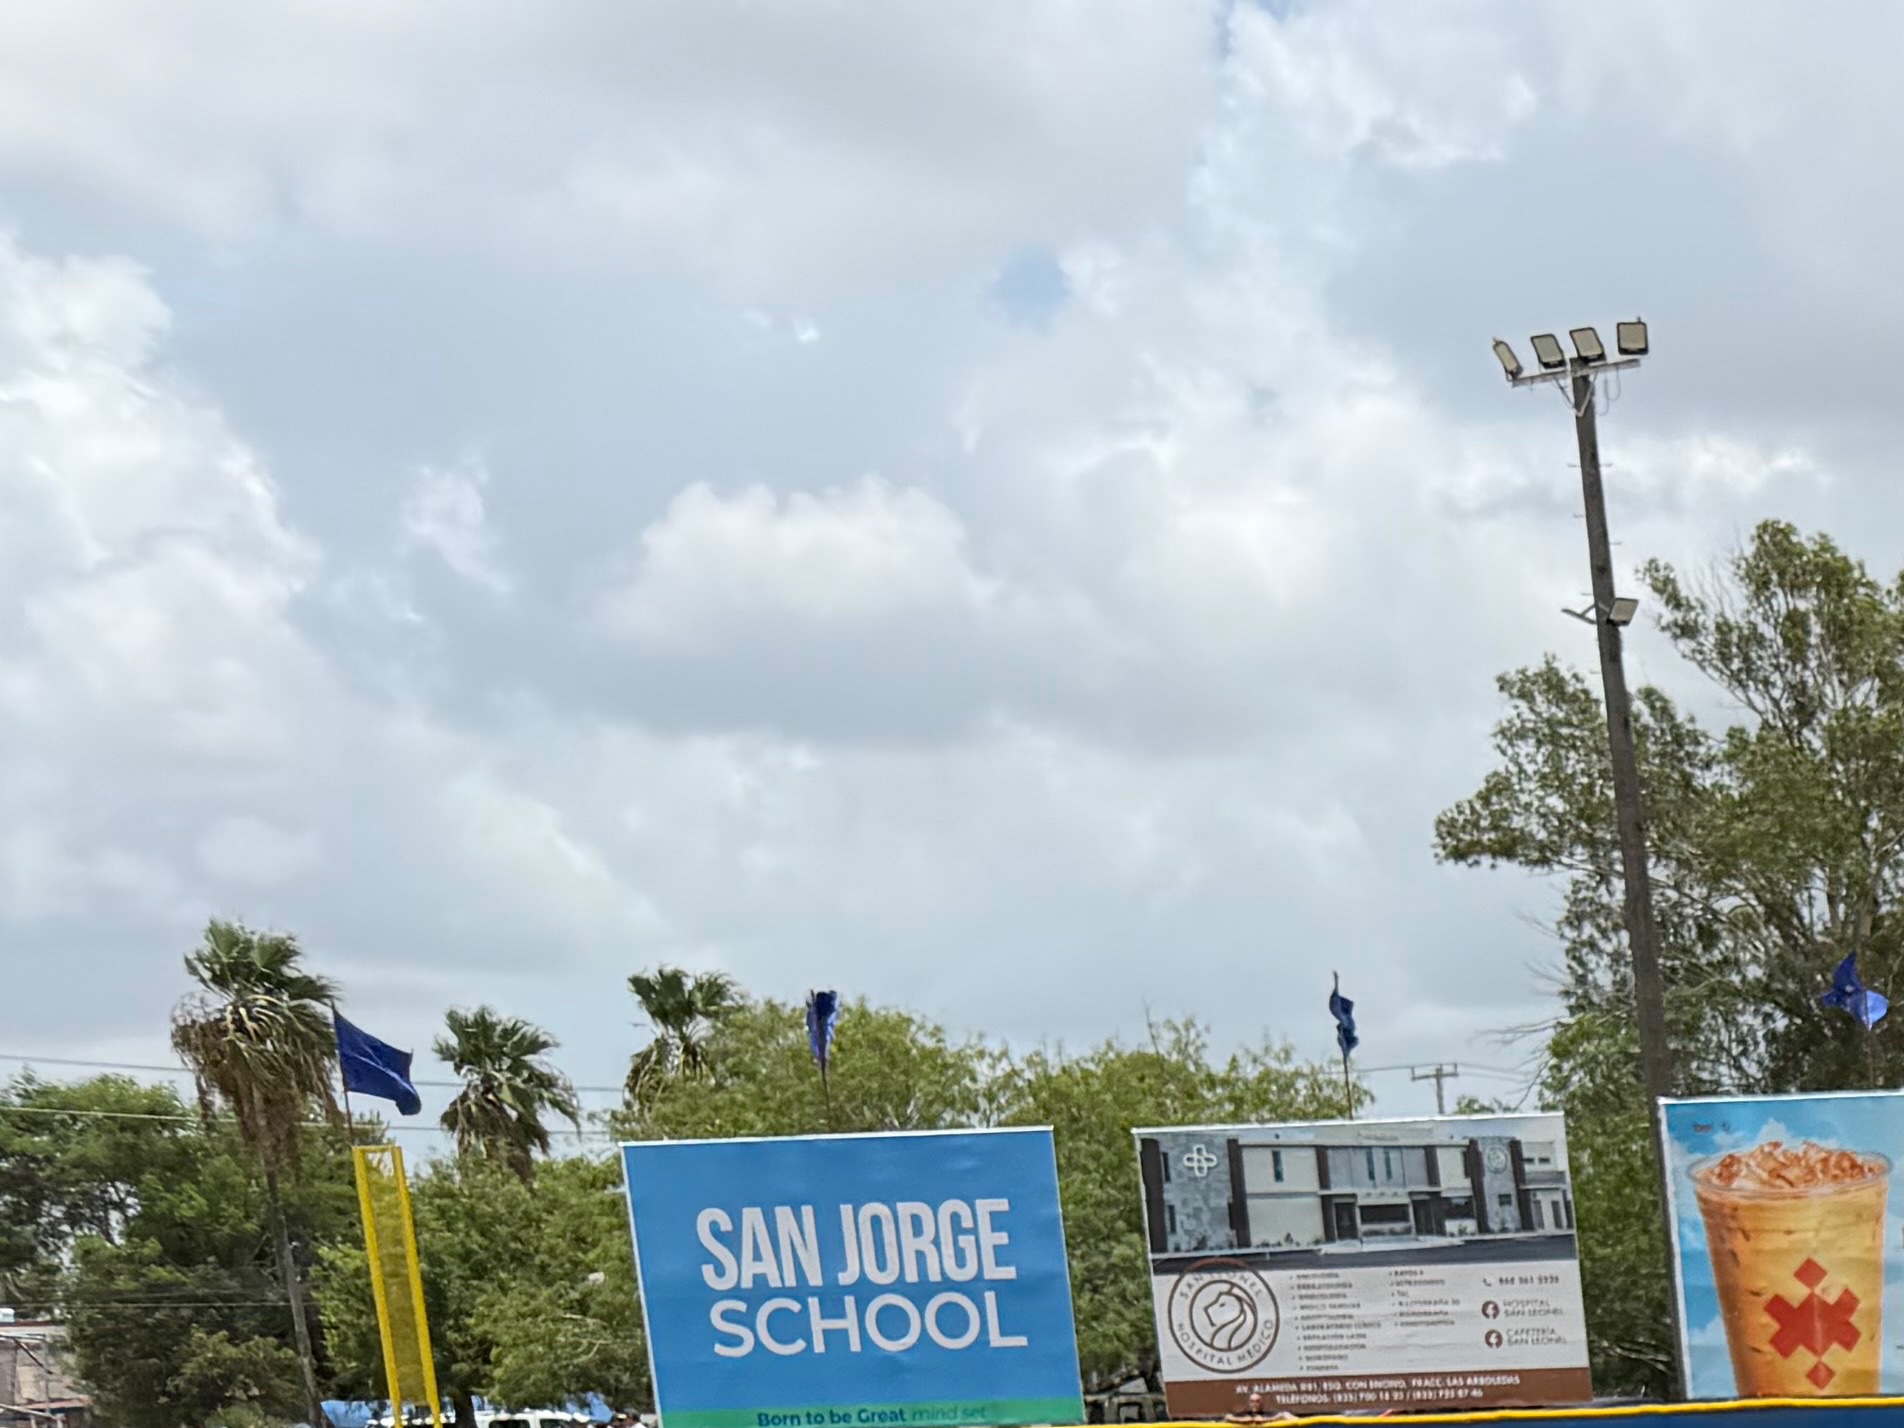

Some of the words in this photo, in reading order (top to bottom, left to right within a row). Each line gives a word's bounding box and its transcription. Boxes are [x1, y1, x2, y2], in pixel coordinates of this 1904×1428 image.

[696, 1207, 823, 1290] SAN
[838, 1199, 1017, 1286] JORGE
[710, 1291, 1028, 1357] SCHOOL
[1178, 1323, 1232, 1366] HOSPITAL
[757, 1410, 801, 1428] Born
[806, 1410, 825, 1425] to
[829, 1408, 852, 1425] be
[858, 1408, 906, 1425] Great
